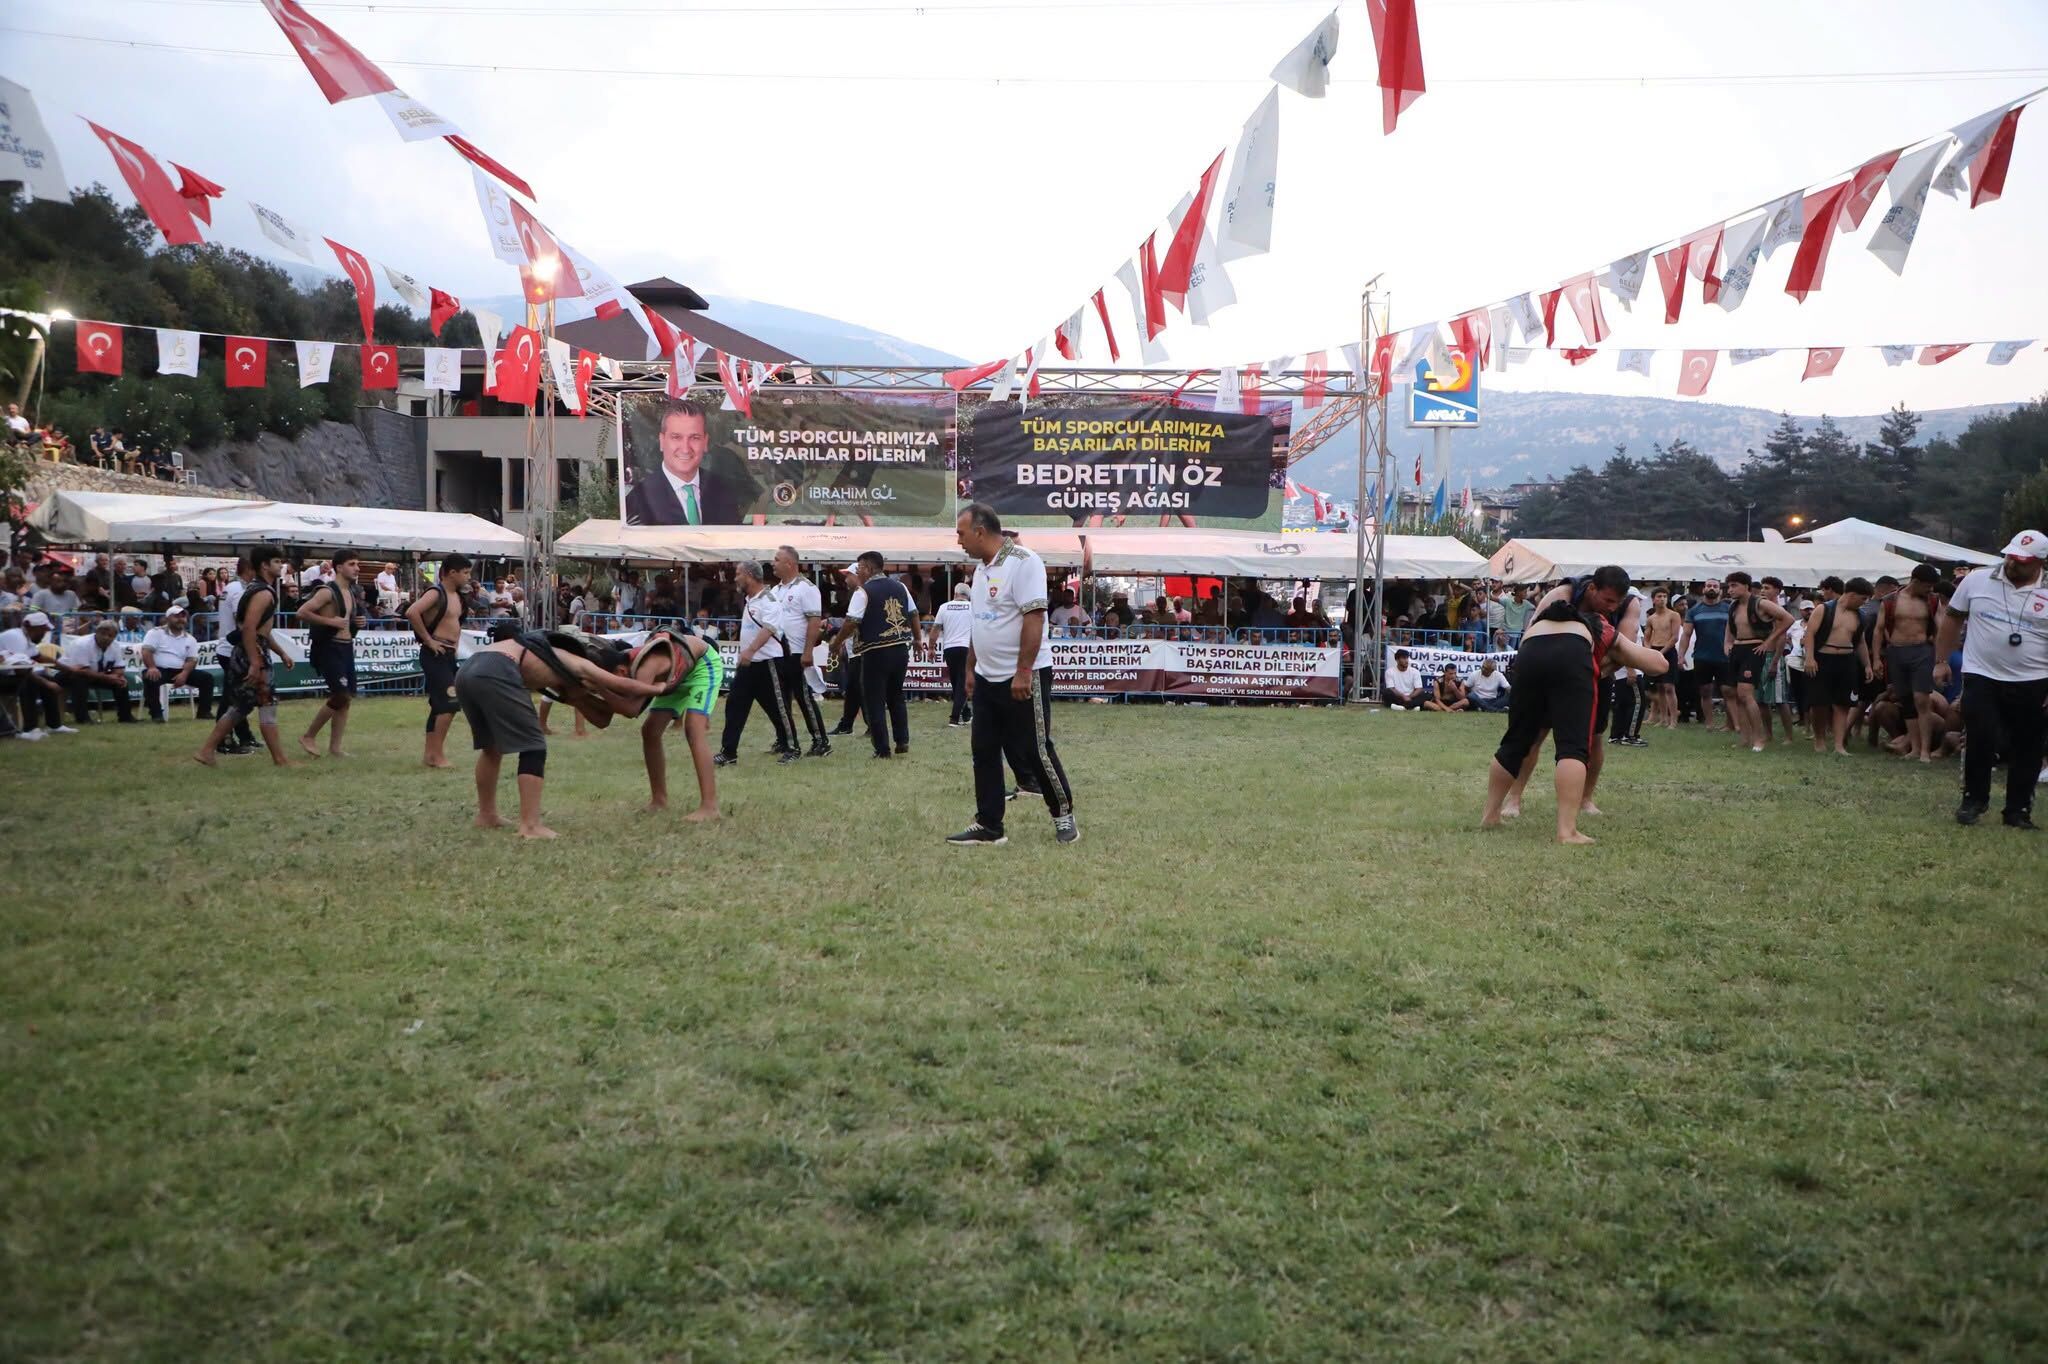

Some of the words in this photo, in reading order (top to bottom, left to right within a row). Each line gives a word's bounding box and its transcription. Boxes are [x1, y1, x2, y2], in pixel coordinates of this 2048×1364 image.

[1020, 417, 1062, 435] TÜM
[1065, 420, 1225, 438] SPORCULARIMIZA
[733, 426, 775, 444] TÜM
[779, 429, 939, 446] SPORCULARIMIZA
[1033, 437, 1138, 456] BAŞARILAR
[1141, 434, 1211, 454] DİLERİM
[747, 446, 850, 465] BAŞARILAR
[854, 444, 926, 463] DİLERİM
[1016, 457, 1176, 486] BEDRETTİN
[1182, 458, 1224, 488] ÖZ
[1046, 487, 1121, 513] GÜREŞ
[1126, 486, 1190, 509] AĞASI
[291, 632, 313, 647] TÜ
[1051, 644, 1151, 655] ORCULARIMIZA
[1177, 644, 1207, 658] TÜM
[1209, 649, 1327, 662] SPORCULARIMIZA
[1089, 653, 1142, 666] DİLERİM
[1186, 658, 1261, 673] BAŞARILAR
[1264, 659, 1317, 673] DİLERİM
[905, 667, 942, 680] AHÇELİ
[1086, 669, 1138, 680] ERDOĞAN
[902, 680, 920, 688] RTİSİ
[1190, 675, 1208, 684] DR.
[1210, 676, 1249, 685] OSMAN
[1250, 677, 1284, 688] AŞKIN
[1285, 677, 1308, 687] BAK
[693, 689, 704, 704] 4
[1206, 686, 1236, 695] GENÇLİK
[1246, 688, 1265, 696] SPOR
[1265, 689, 1292, 697] BAKANI
